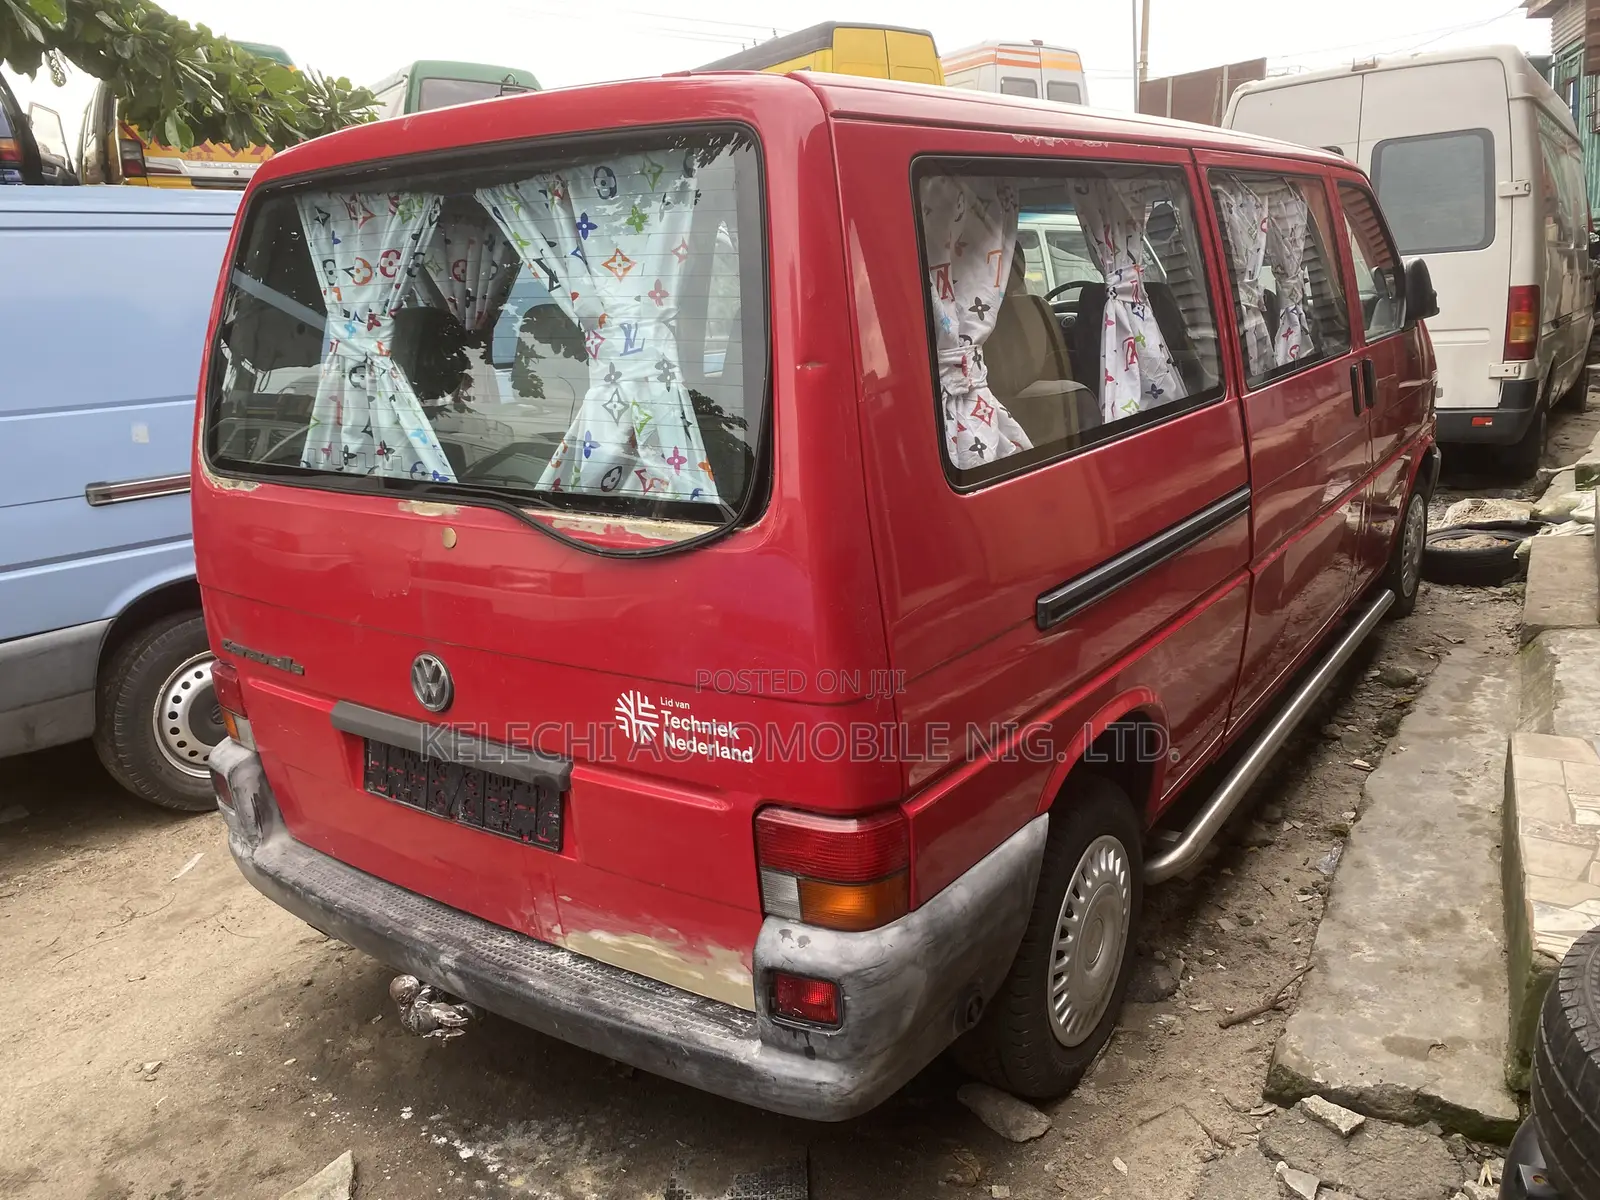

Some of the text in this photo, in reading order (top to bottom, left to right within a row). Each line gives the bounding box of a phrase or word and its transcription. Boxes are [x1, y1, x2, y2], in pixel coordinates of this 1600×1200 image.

[660, 696, 690, 709] Lid van
[660, 709, 740, 740] Techniek
[663, 730, 754, 763] Nederland
